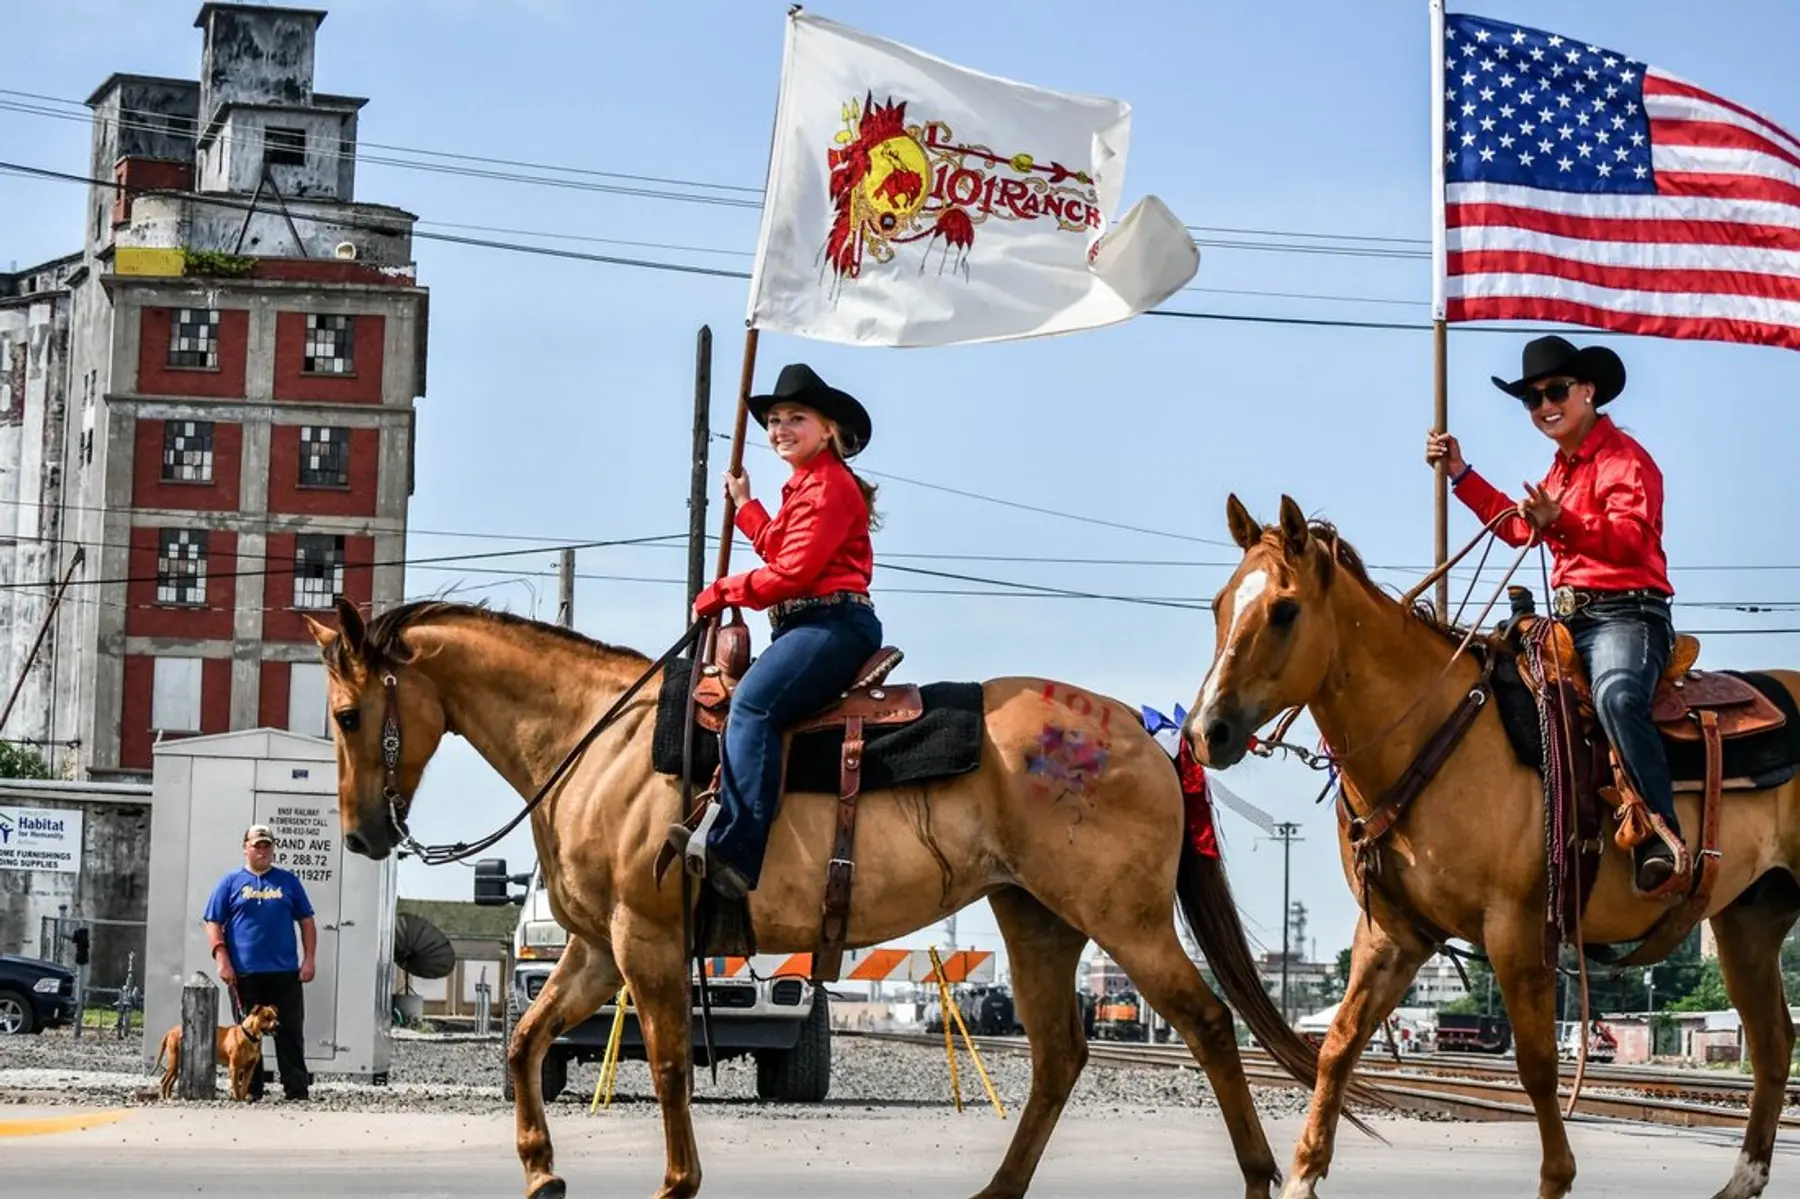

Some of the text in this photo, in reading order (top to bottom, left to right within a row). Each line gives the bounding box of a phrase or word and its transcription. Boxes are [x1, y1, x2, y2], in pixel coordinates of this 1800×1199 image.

[929, 164, 1102, 230] 101 RANCH
[1042, 684, 1111, 734] 101
[294, 808, 320, 817] RAILWAY
[18, 817, 64, 832] Habitat
[276, 817, 312, 826] EMERGENCY
[313, 819, 328, 828] CALL
[30, 832, 64, 840] Humanity
[273, 838, 331, 852] RAND AVE
[17, 851, 71, 860] FURNISHINGS
[292, 854, 327, 867] 288.72
[20, 860, 59, 869] SUPPLIES
[291, 868, 332, 881] 11927F
